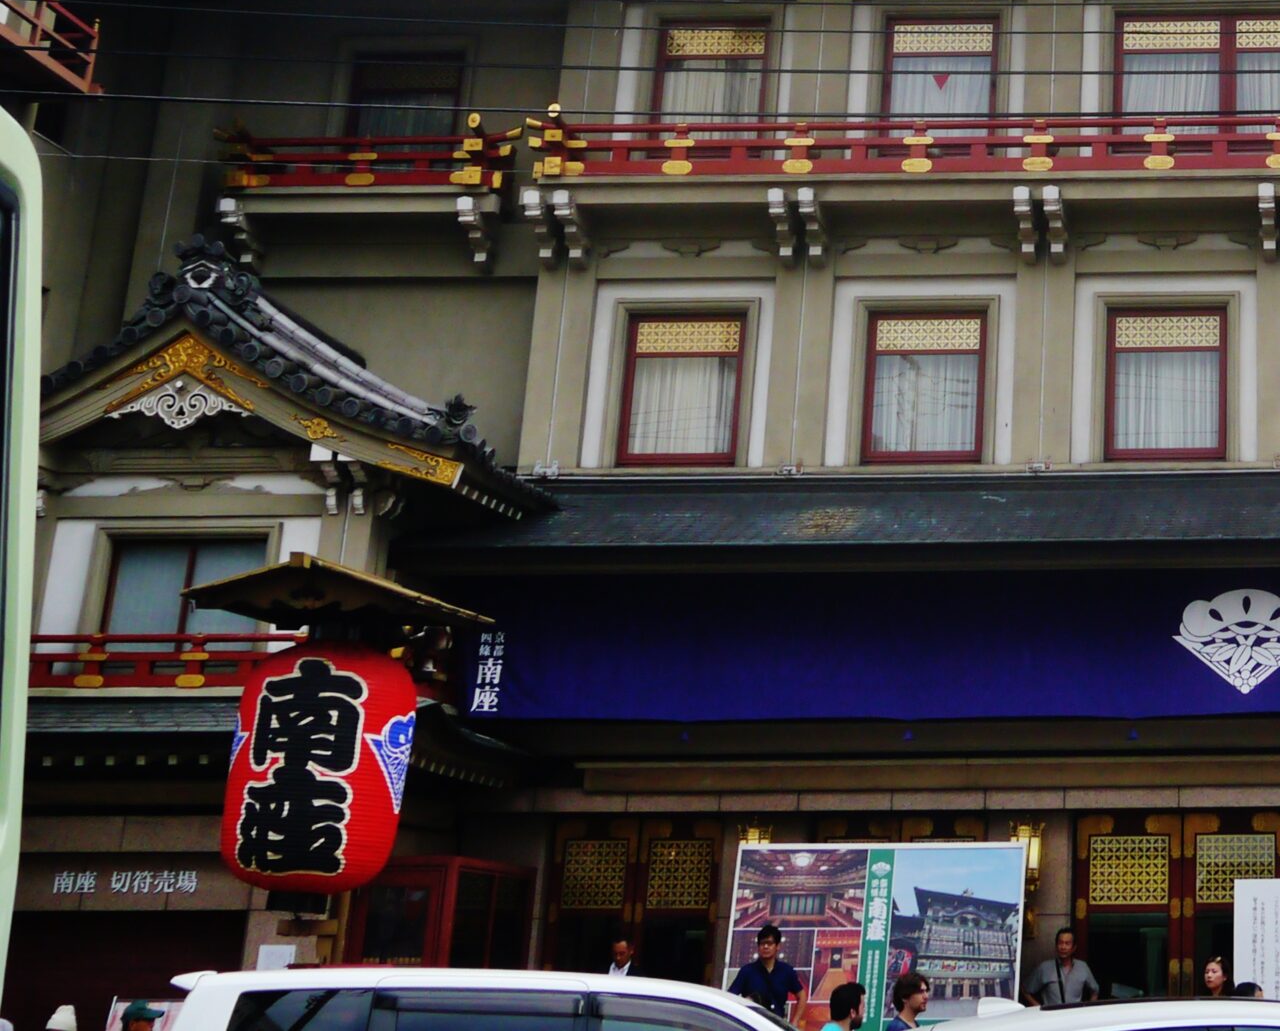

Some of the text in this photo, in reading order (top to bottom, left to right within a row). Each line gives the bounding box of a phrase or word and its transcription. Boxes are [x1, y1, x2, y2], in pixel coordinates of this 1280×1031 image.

[470, 657, 503, 712] 南座
[235, 656, 368, 876] 南座
[52, 870, 198, 894] 南座 切符売場
